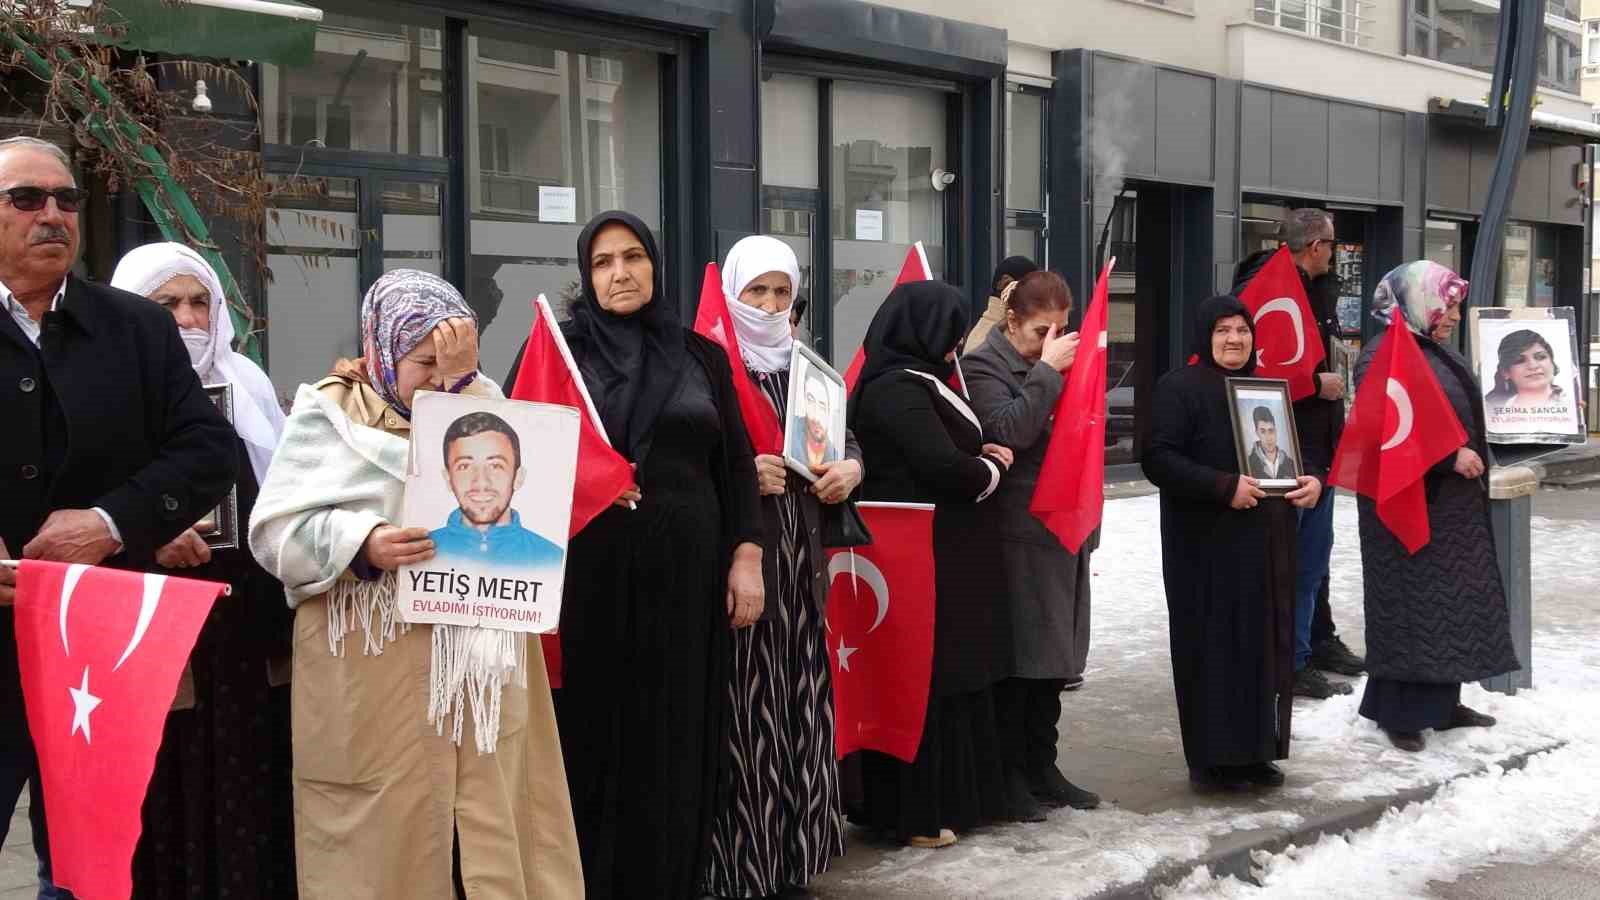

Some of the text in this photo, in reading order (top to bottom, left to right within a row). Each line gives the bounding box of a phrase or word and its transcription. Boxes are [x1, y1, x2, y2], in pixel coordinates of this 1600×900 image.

[409, 568, 543, 603] YETİŞ MERT
[413, 600, 469, 615] EVLADIMI
